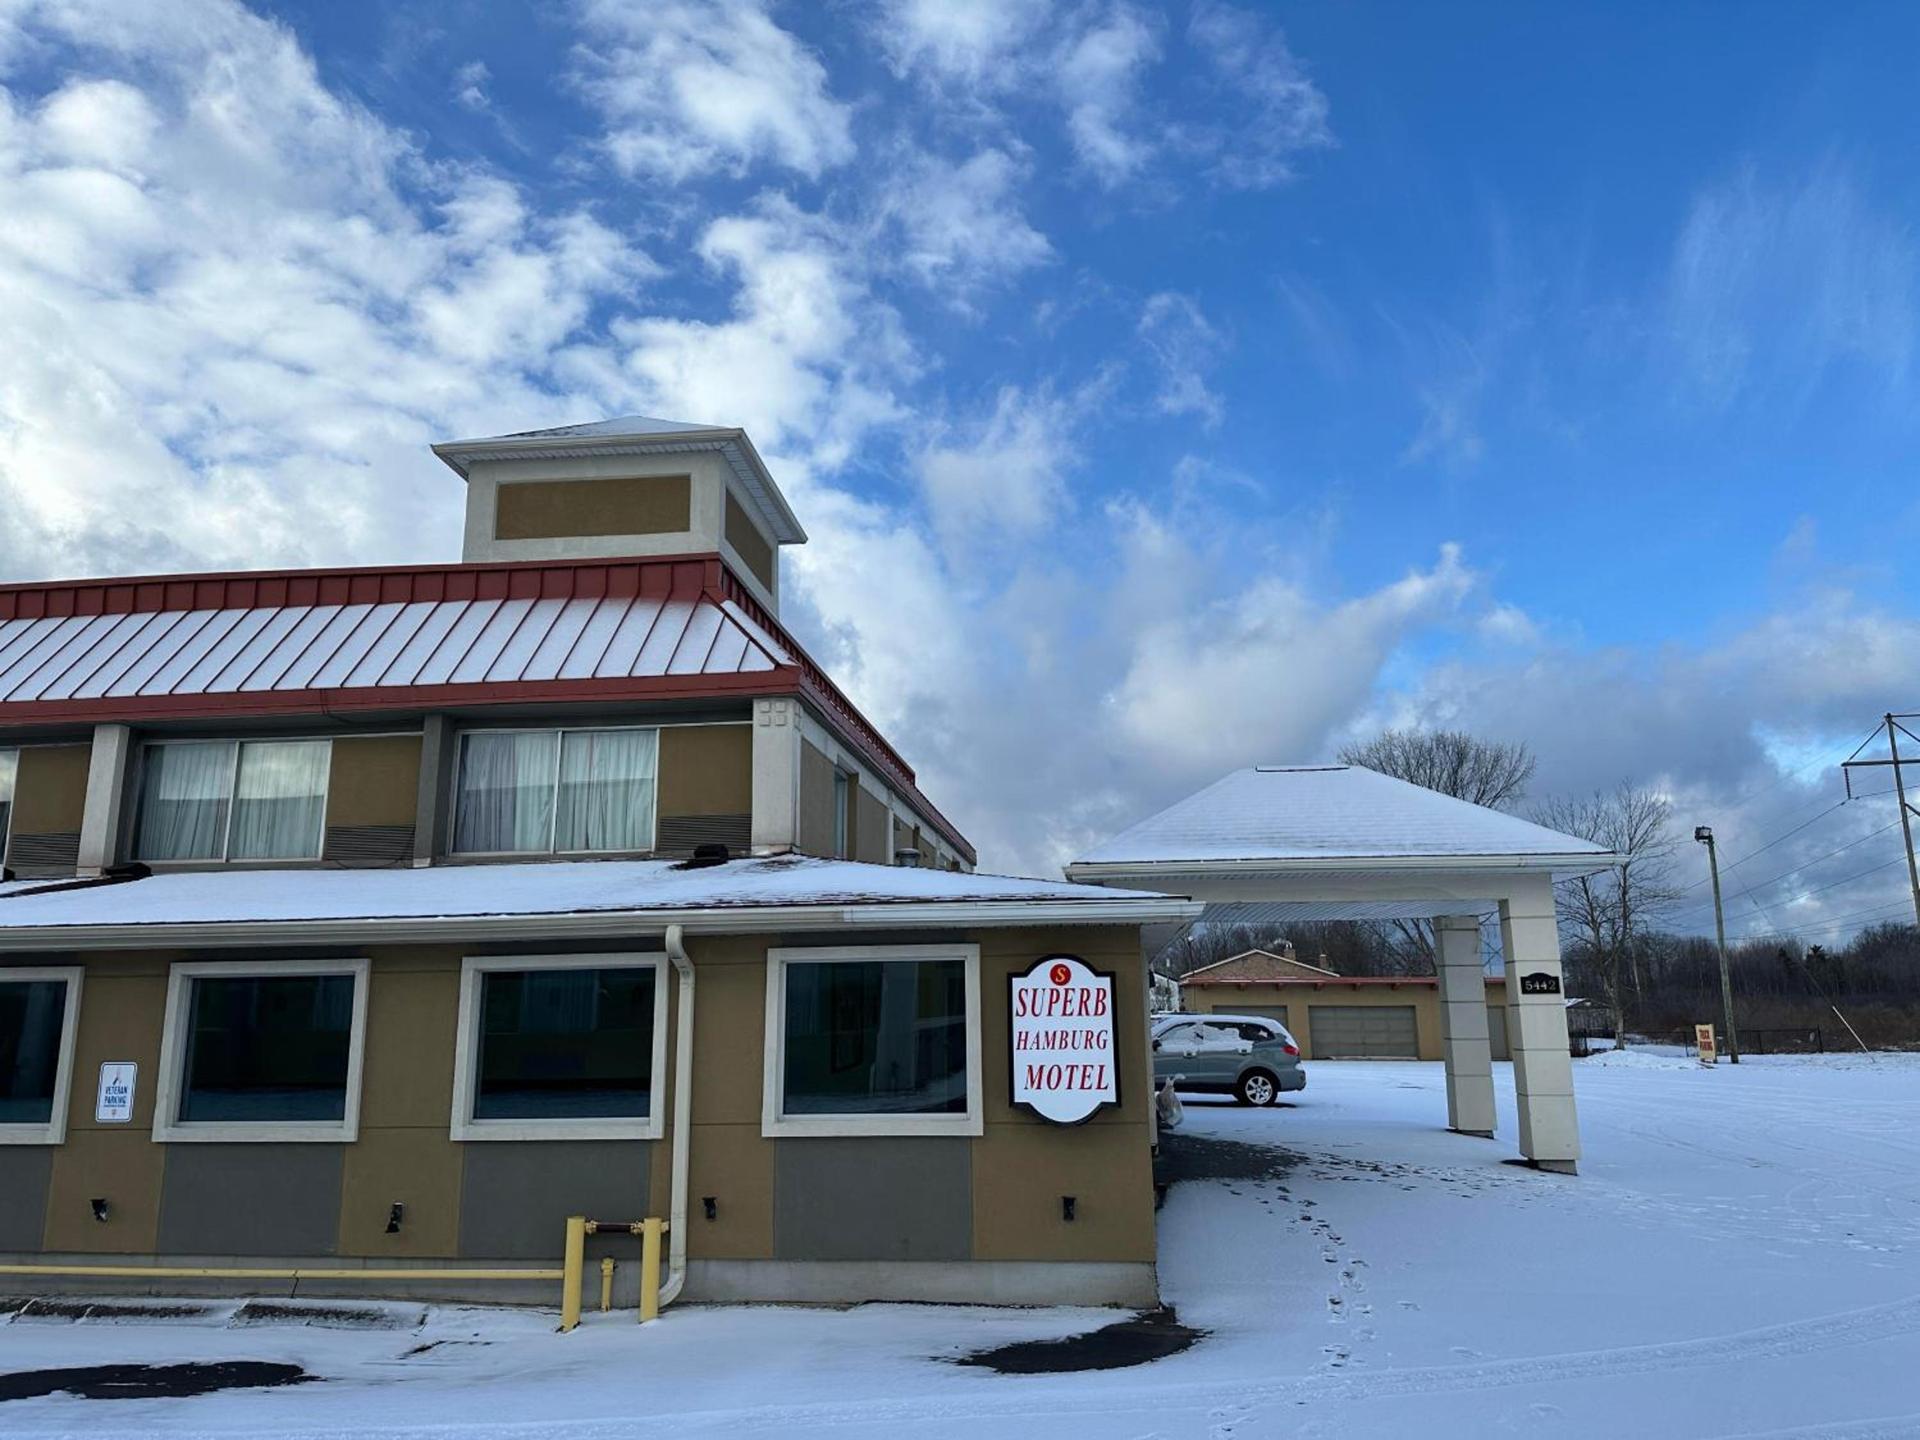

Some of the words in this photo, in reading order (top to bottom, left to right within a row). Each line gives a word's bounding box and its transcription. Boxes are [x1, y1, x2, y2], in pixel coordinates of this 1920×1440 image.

[1055, 967, 1066, 982] S
[1525, 980, 1557, 990] 5442
[1015, 987, 1107, 1017] SUPERB
[1016, 1029, 1108, 1050] HAMBURG
[1024, 1064, 1109, 1090] MOTEL
[105, 1086, 128, 1095] VETERAN
[104, 1095, 127, 1104] PARKING
